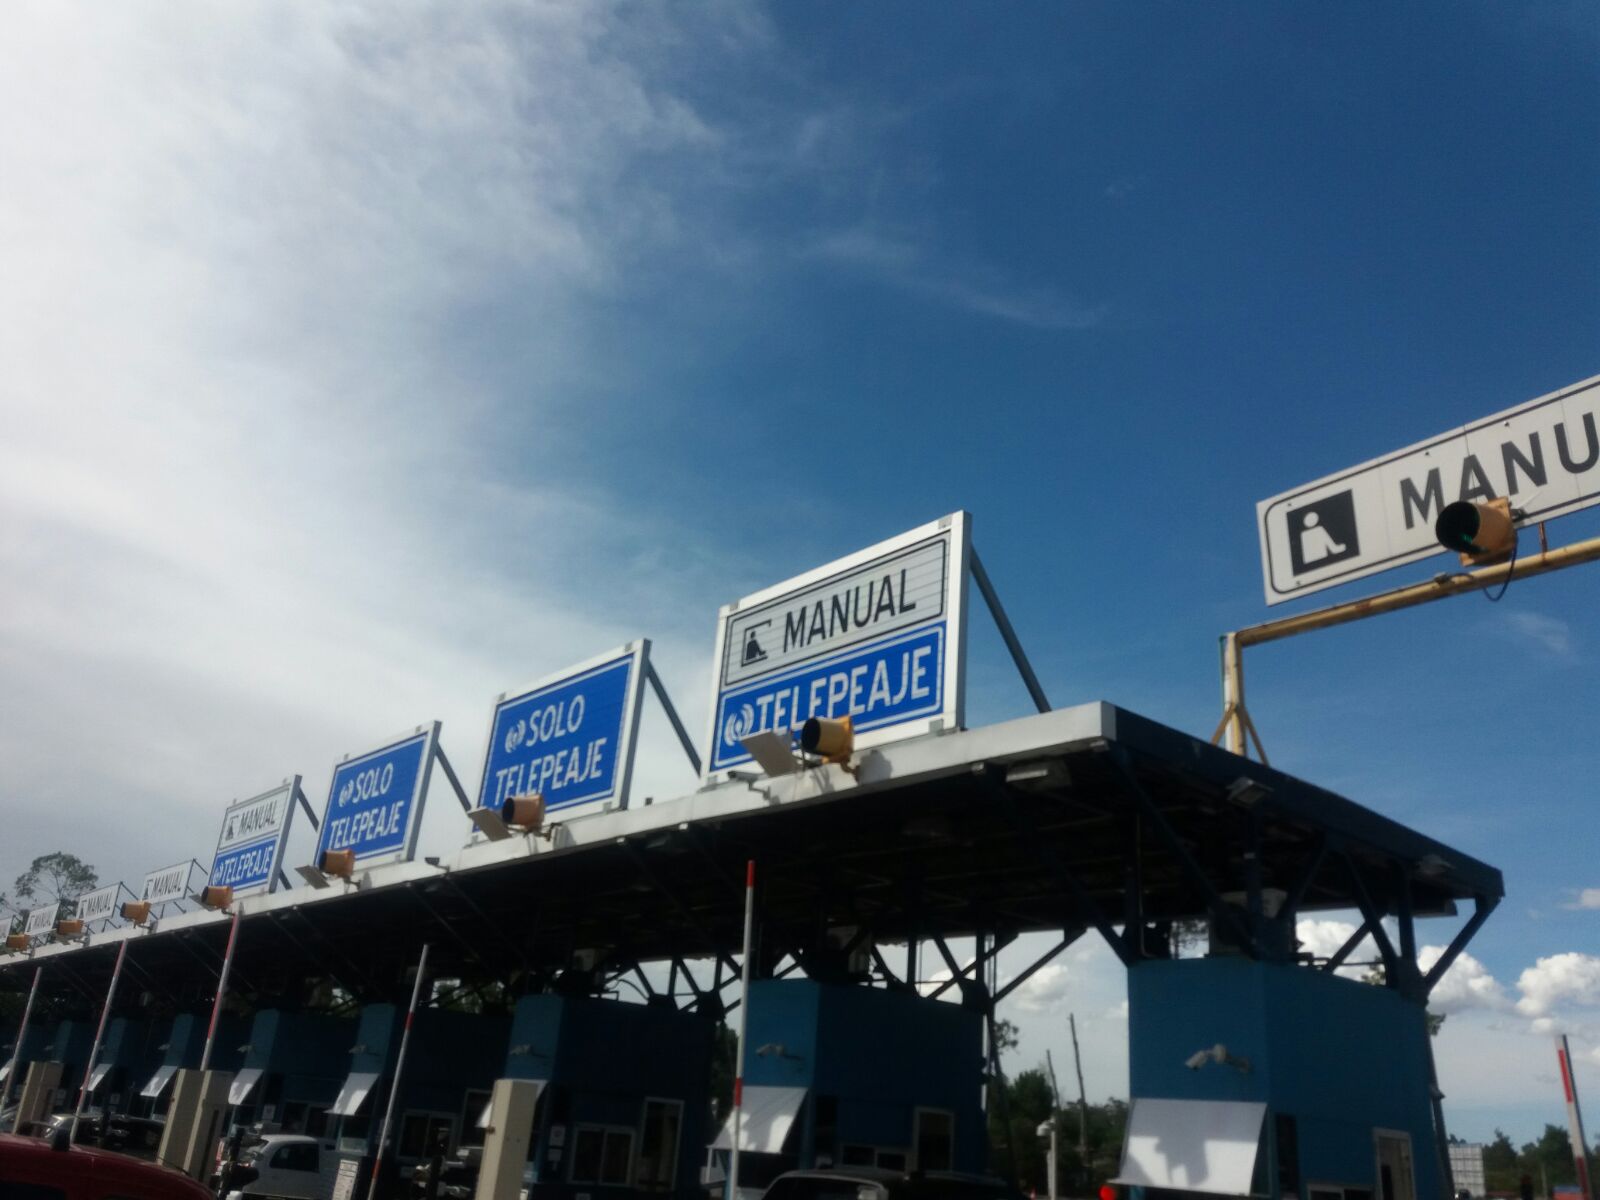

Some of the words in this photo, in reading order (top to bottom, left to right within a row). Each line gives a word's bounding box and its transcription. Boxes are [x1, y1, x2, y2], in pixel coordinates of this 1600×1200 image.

[783, 568, 916, 653] MANUAL
[757, 647, 930, 735] TELEPEAJE
[526, 694, 586, 747] SOLO
[352, 761, 394, 804] SOLO
[495, 738, 604, 804] TELEPEAJE
[238, 800, 277, 836] MANUAL
[329, 801, 404, 849] TELEPEAJE
[152, 870, 184, 897] MANUAL
[222, 846, 273, 886] TELEPEAJE
[86, 891, 112, 915] MANUAL
